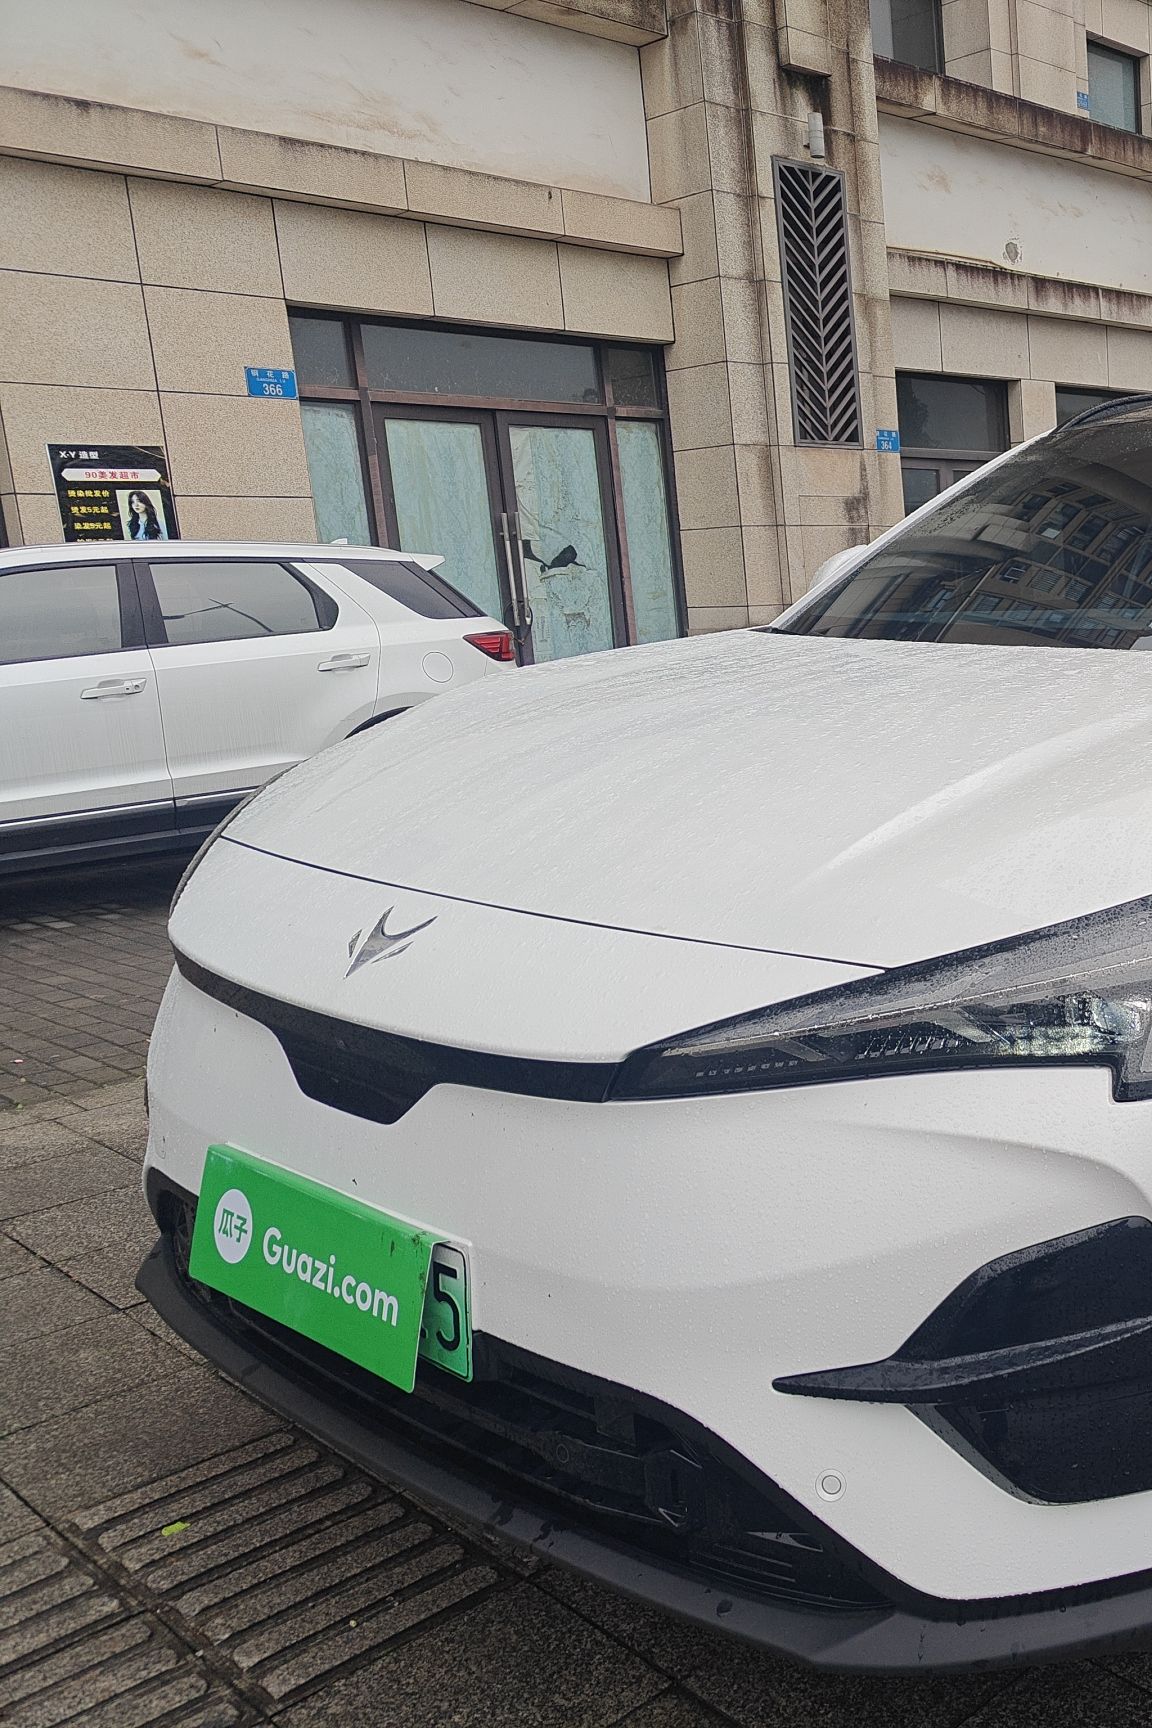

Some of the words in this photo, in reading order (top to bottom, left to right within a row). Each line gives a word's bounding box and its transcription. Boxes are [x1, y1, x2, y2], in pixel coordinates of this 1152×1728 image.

[262, 383, 283, 396] 366
[881, 440, 892, 450] 364
[79, 451, 99, 460] 造型
[85, 471, 139, 480] 90美发超市
[218, 1207, 248, 1243] 瓜子
[262, 1226, 399, 1327] Guazi.com
